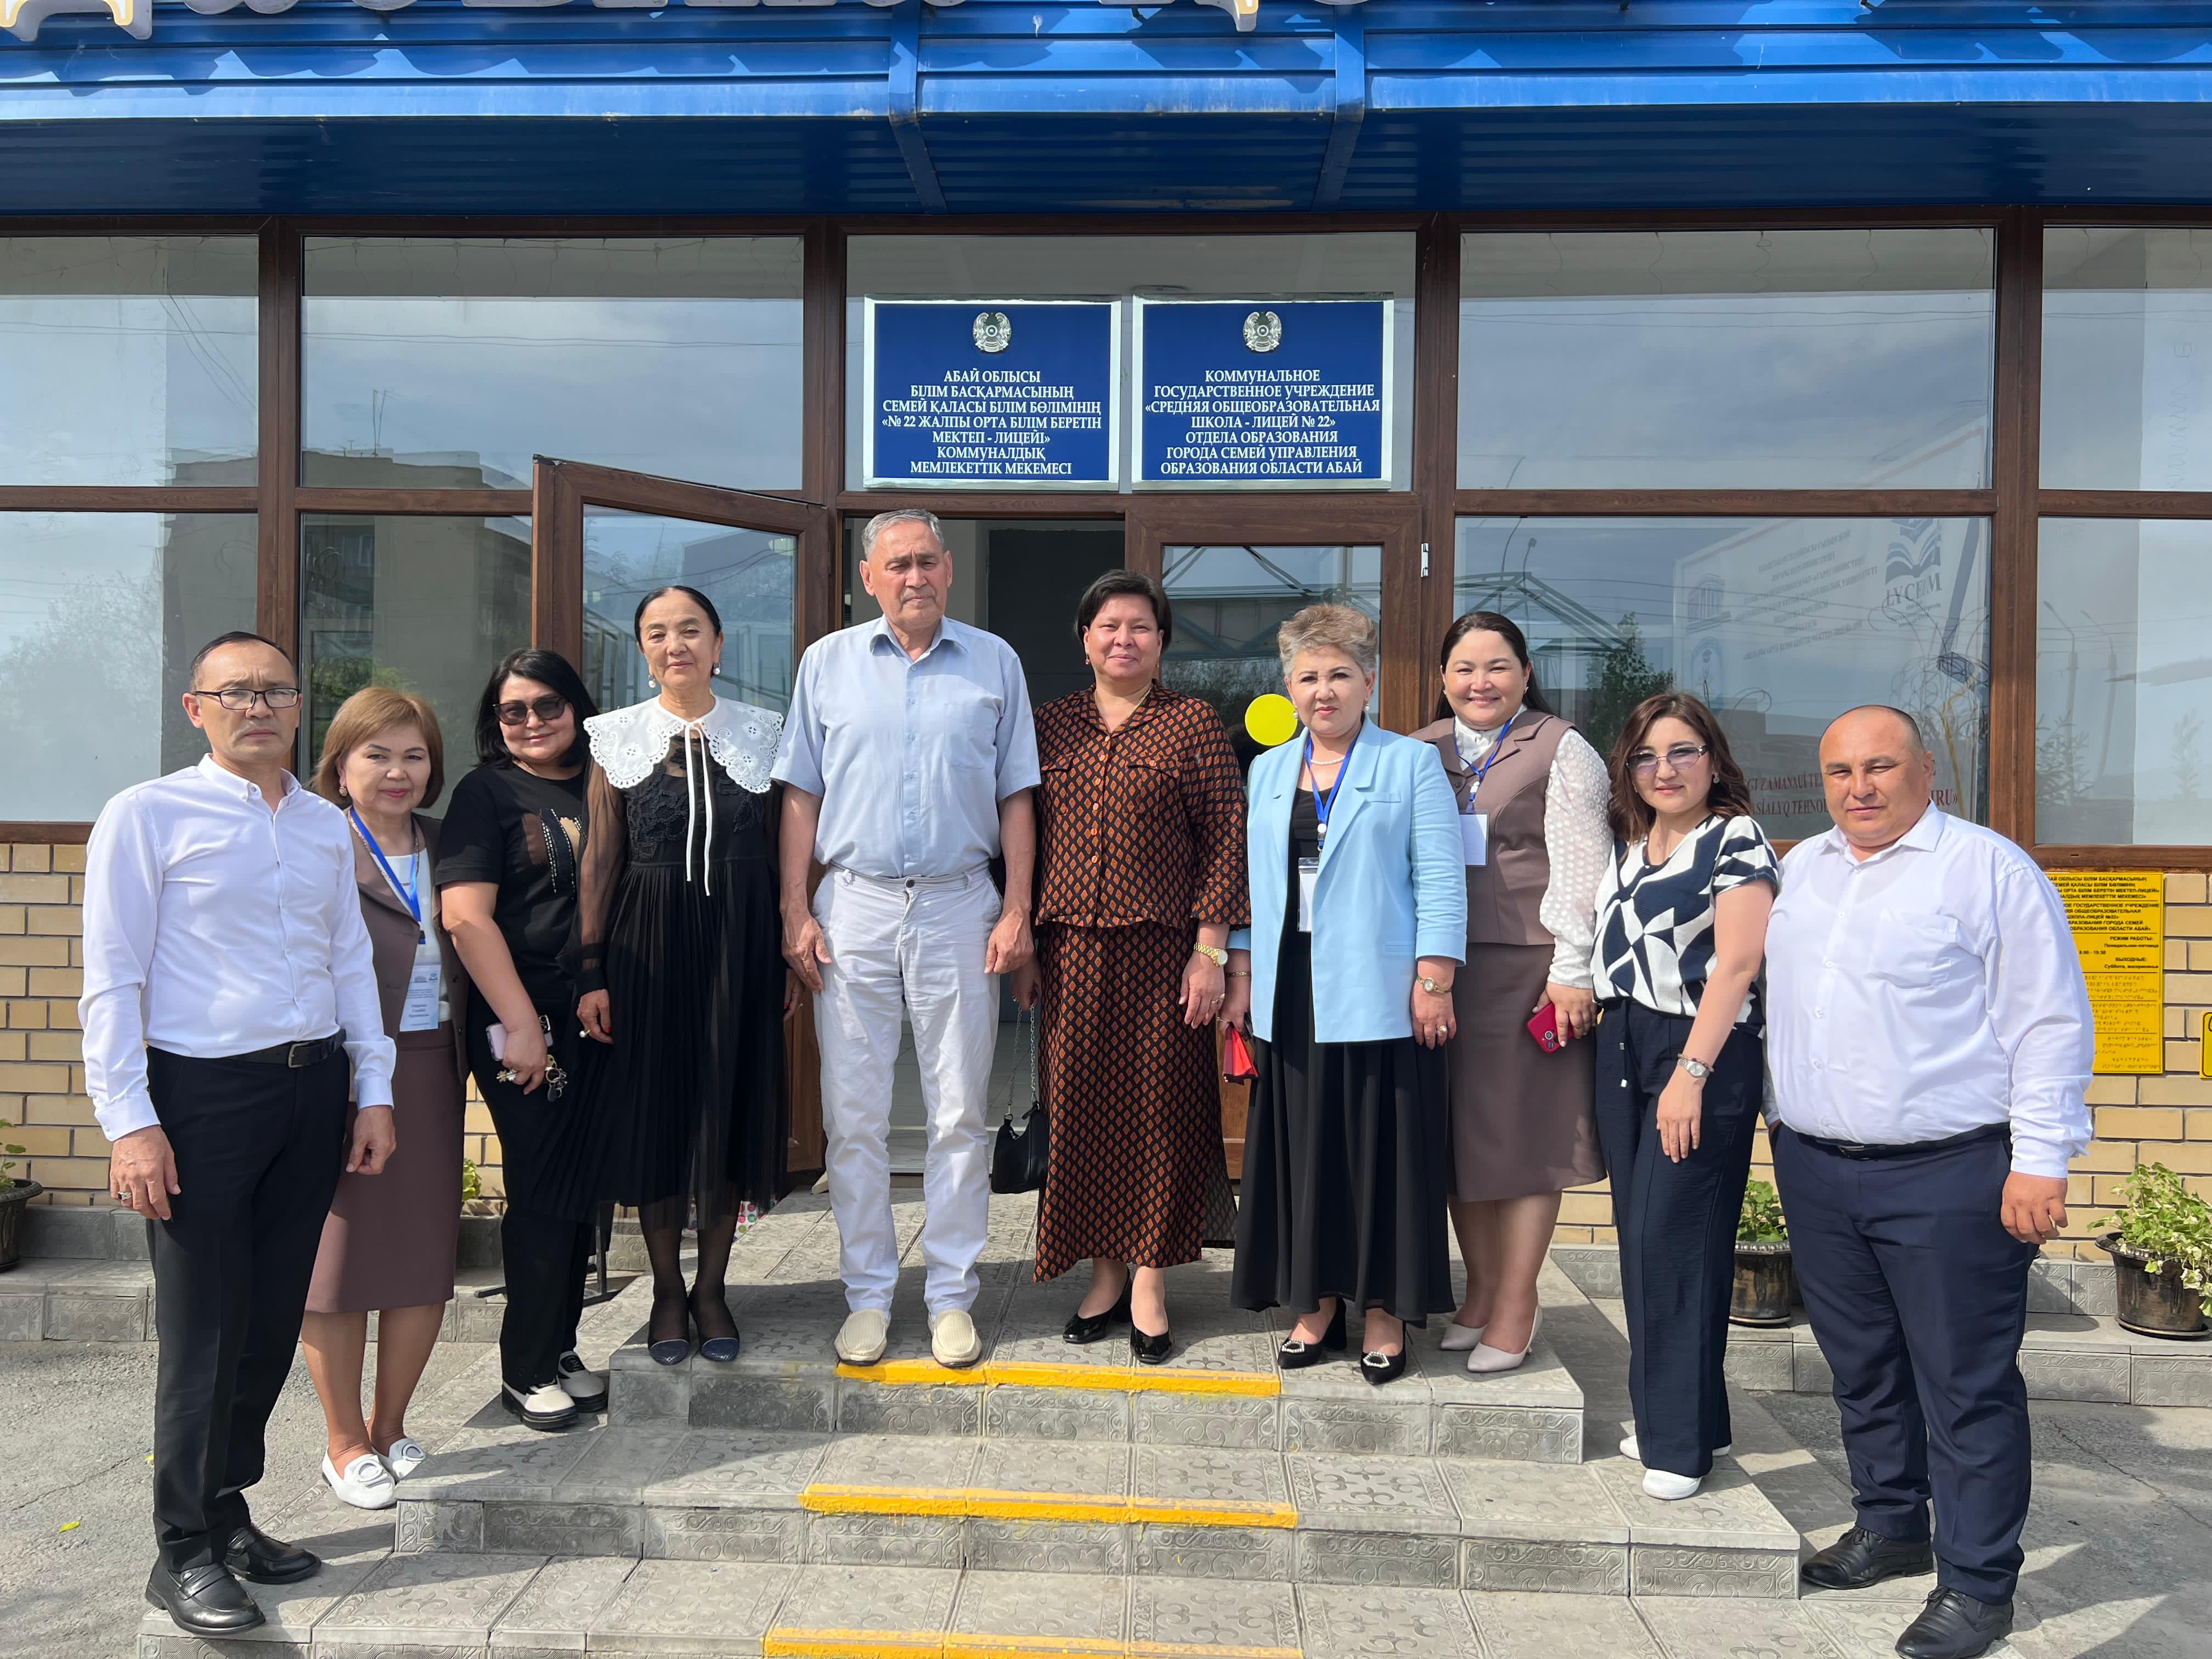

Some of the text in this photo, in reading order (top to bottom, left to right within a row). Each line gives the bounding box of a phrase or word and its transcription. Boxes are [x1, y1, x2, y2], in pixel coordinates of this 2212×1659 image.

[944, 368, 1041, 383] АБАЙ ОБЛЫСЫ
[1205, 369, 1320, 385] КОММУНАЛЬНОЕ
[910, 385, 1074, 400] БІЛІМ БАСҚАРМАСЫНЫҢ
[1154, 384, 1374, 400] ГОСУДАРСТВЕННОЕ УЧРЕЖДЕНИЕ
[883, 399, 1102, 416] СЕМЕЙ ҚАЛАСЫ БІЛІМ БӨЛІМІНІҢ
[1145, 399, 1380, 416] «СРЕДНЯЯ ОБЩЕОБРАЗОВАТЕЛЬНАЯ
[882, 415, 1102, 429] «№ 22 ЖАЛПЫ ОРТА БІЛІМ БЕРЕТІН
[1191, 416, 1243, 428] ШКОЛА
[1251, 414, 1299, 430] ЛИЦЕЙ
[1301, 415, 1315, 427] №
[1317, 415, 1336, 427] 22»
[932, 431, 985, 443] МЕКТЕП
[994, 429, 1051, 446] ЛИЦЕЙІ»
[1186, 431, 1338, 446] ОТДЕЛА ОБРАЗОВАНИЯ
[937, 446, 1046, 462] КОММУНАЛДЫҚ
[1166, 444, 1359, 462] ГОРОДА СЕМЕЙ УПРАВЛЕНИЯ
[910, 461, 1072, 475] МЕМЛЕКЕТТІК МЕКЕМЕСІ
[1160, 458, 1362, 474] ОБРАЗОВАНИЯ ОБЛАСТИ АБАЙ
